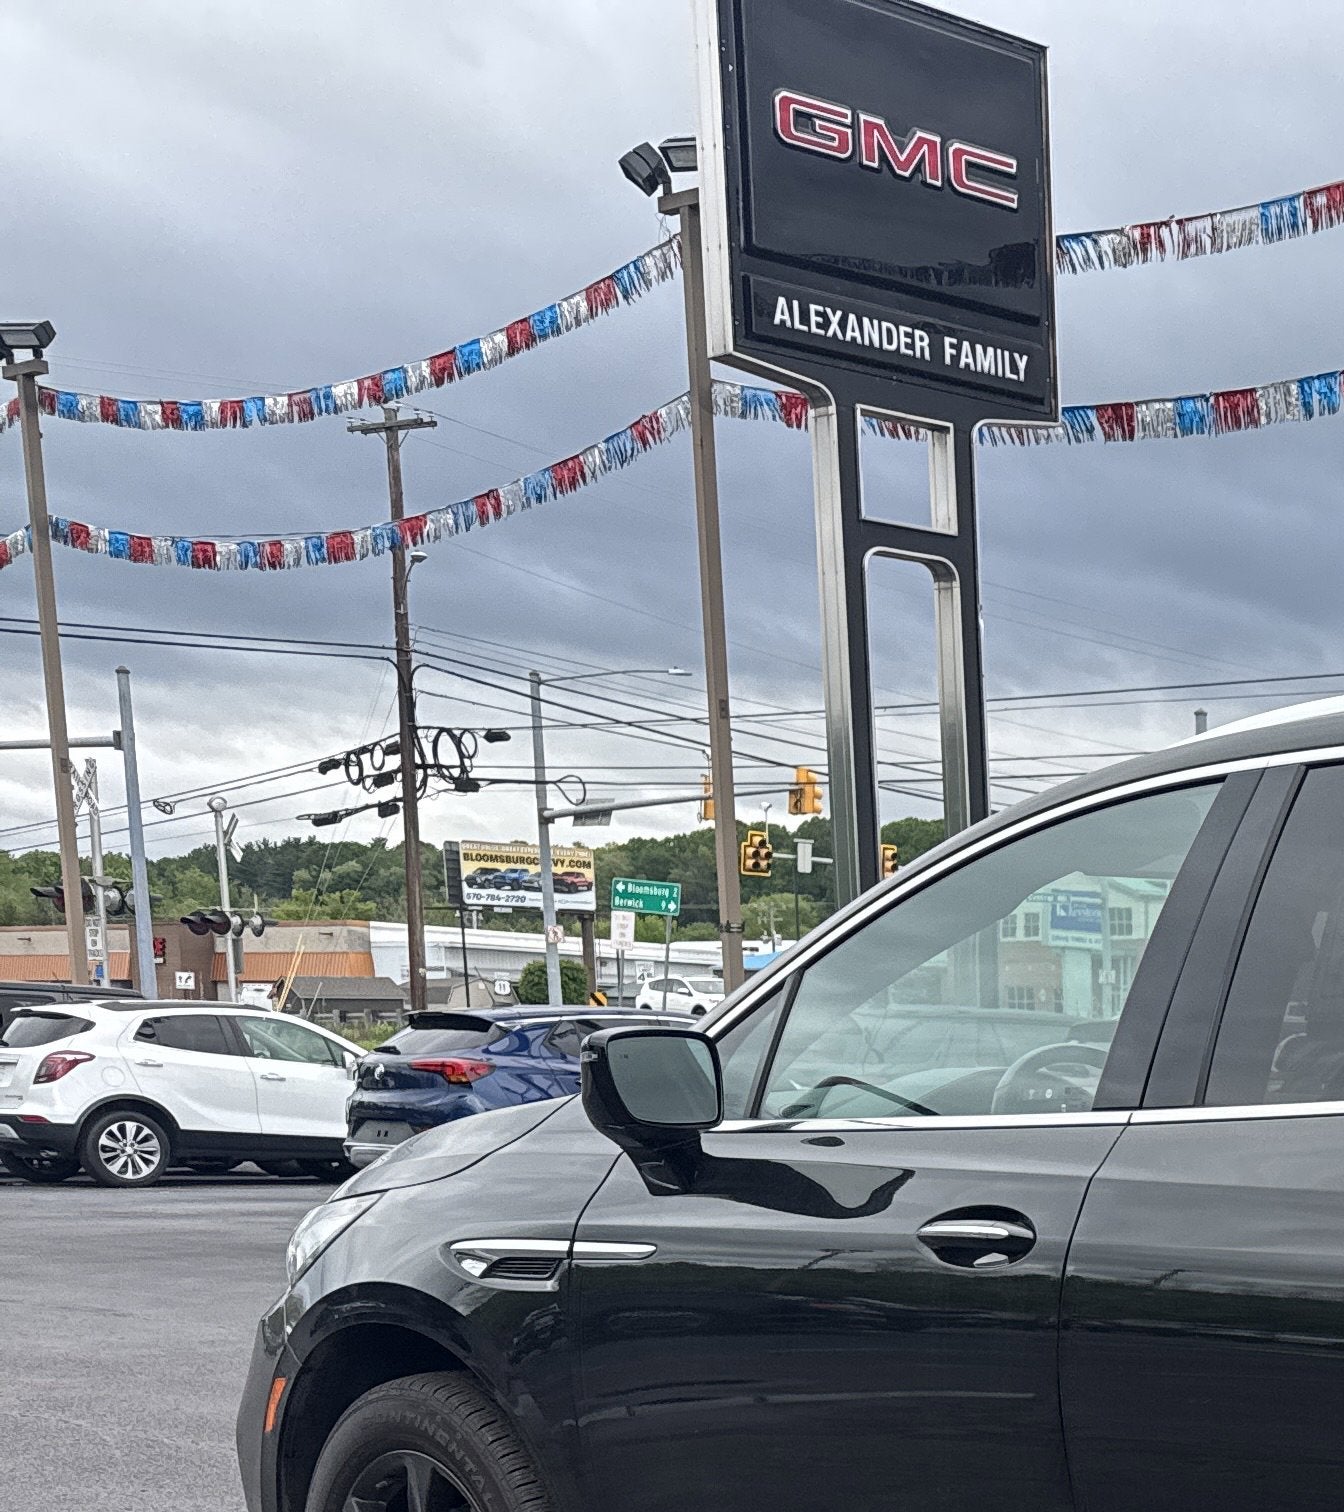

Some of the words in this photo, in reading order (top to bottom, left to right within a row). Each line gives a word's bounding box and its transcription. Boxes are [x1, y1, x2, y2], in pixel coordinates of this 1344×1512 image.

[775, 89, 1018, 209] GMC
[774, 296, 931, 362] ALEXANDER
[943, 336, 1029, 382] FAMILY
[462, 852, 592, 869] BLOOMSBURGCVY.COM
[628, 883, 670, 898] Bloomsburg
[614, 896, 644, 908] Berwick
